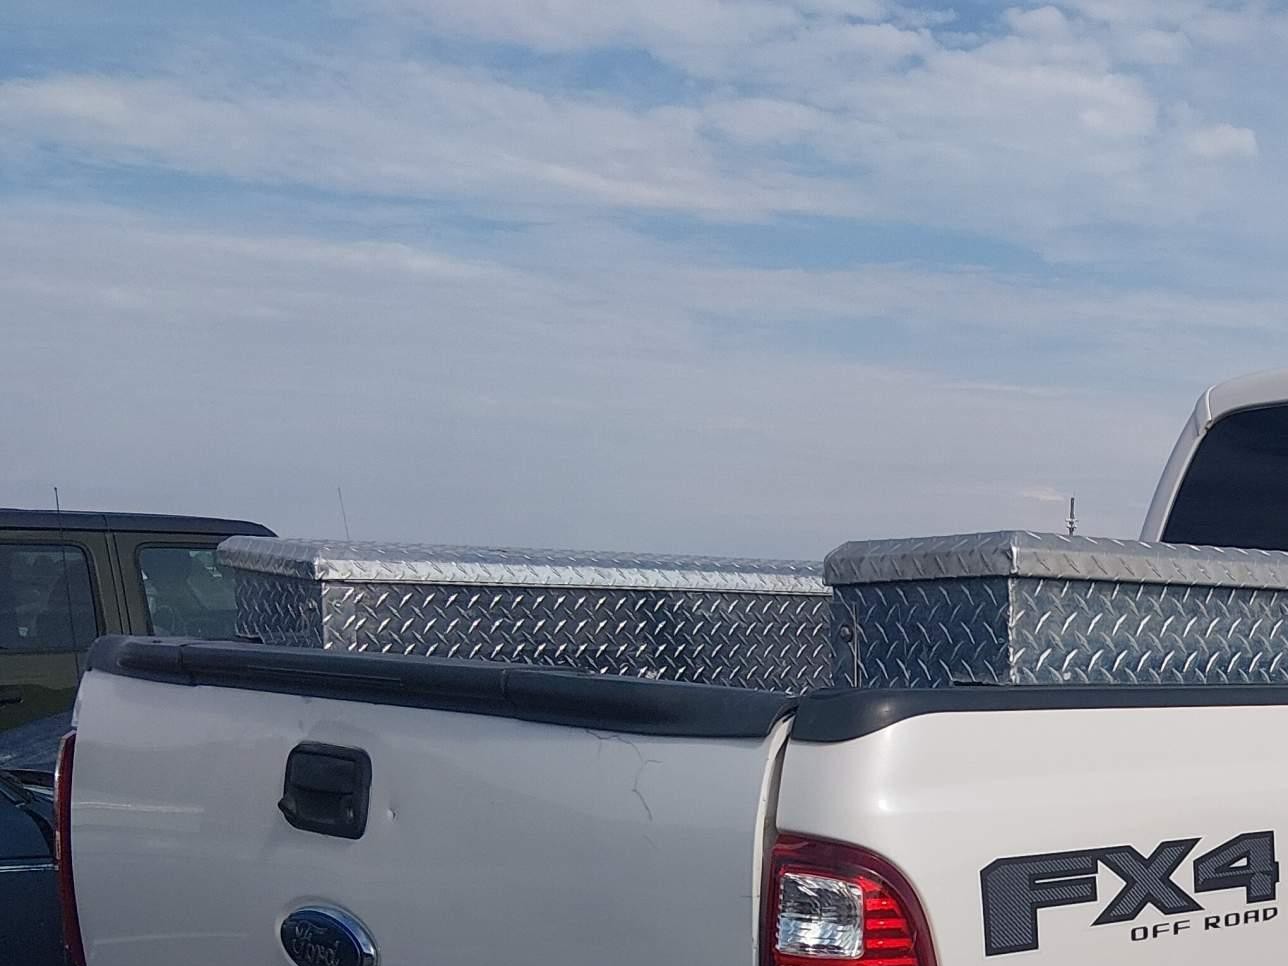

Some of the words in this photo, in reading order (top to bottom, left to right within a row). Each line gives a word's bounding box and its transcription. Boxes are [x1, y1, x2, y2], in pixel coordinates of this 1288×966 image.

[980, 830, 1279, 957] FX4
[1130, 919, 1191, 941] OFF
[1204, 906, 1278, 930] ROAD
